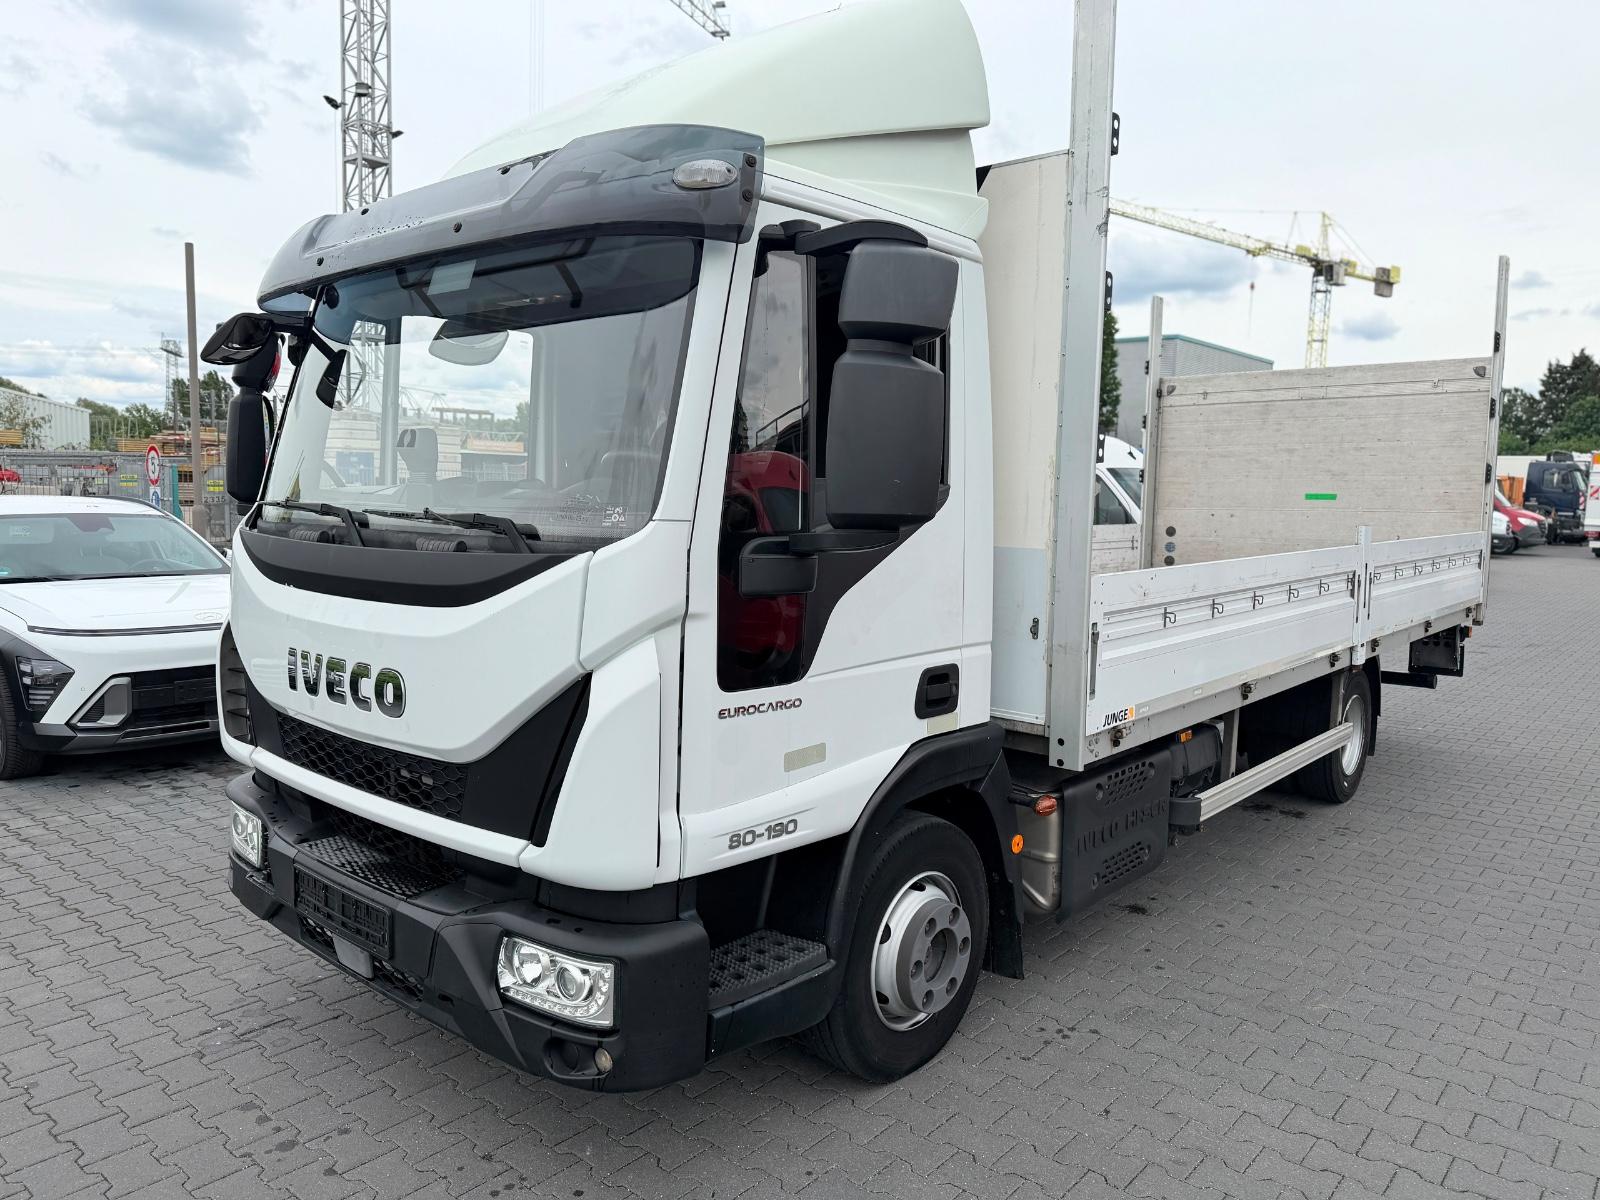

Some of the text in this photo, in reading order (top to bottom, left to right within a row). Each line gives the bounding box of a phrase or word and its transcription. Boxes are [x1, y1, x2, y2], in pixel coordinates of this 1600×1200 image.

[150, 456, 157, 475] 5
[287, 646, 407, 719] IVECO
[717, 697, 803, 720] EUROCARGO
[1103, 708, 1129, 728] JUNGE
[727, 818, 798, 850] 80-190
